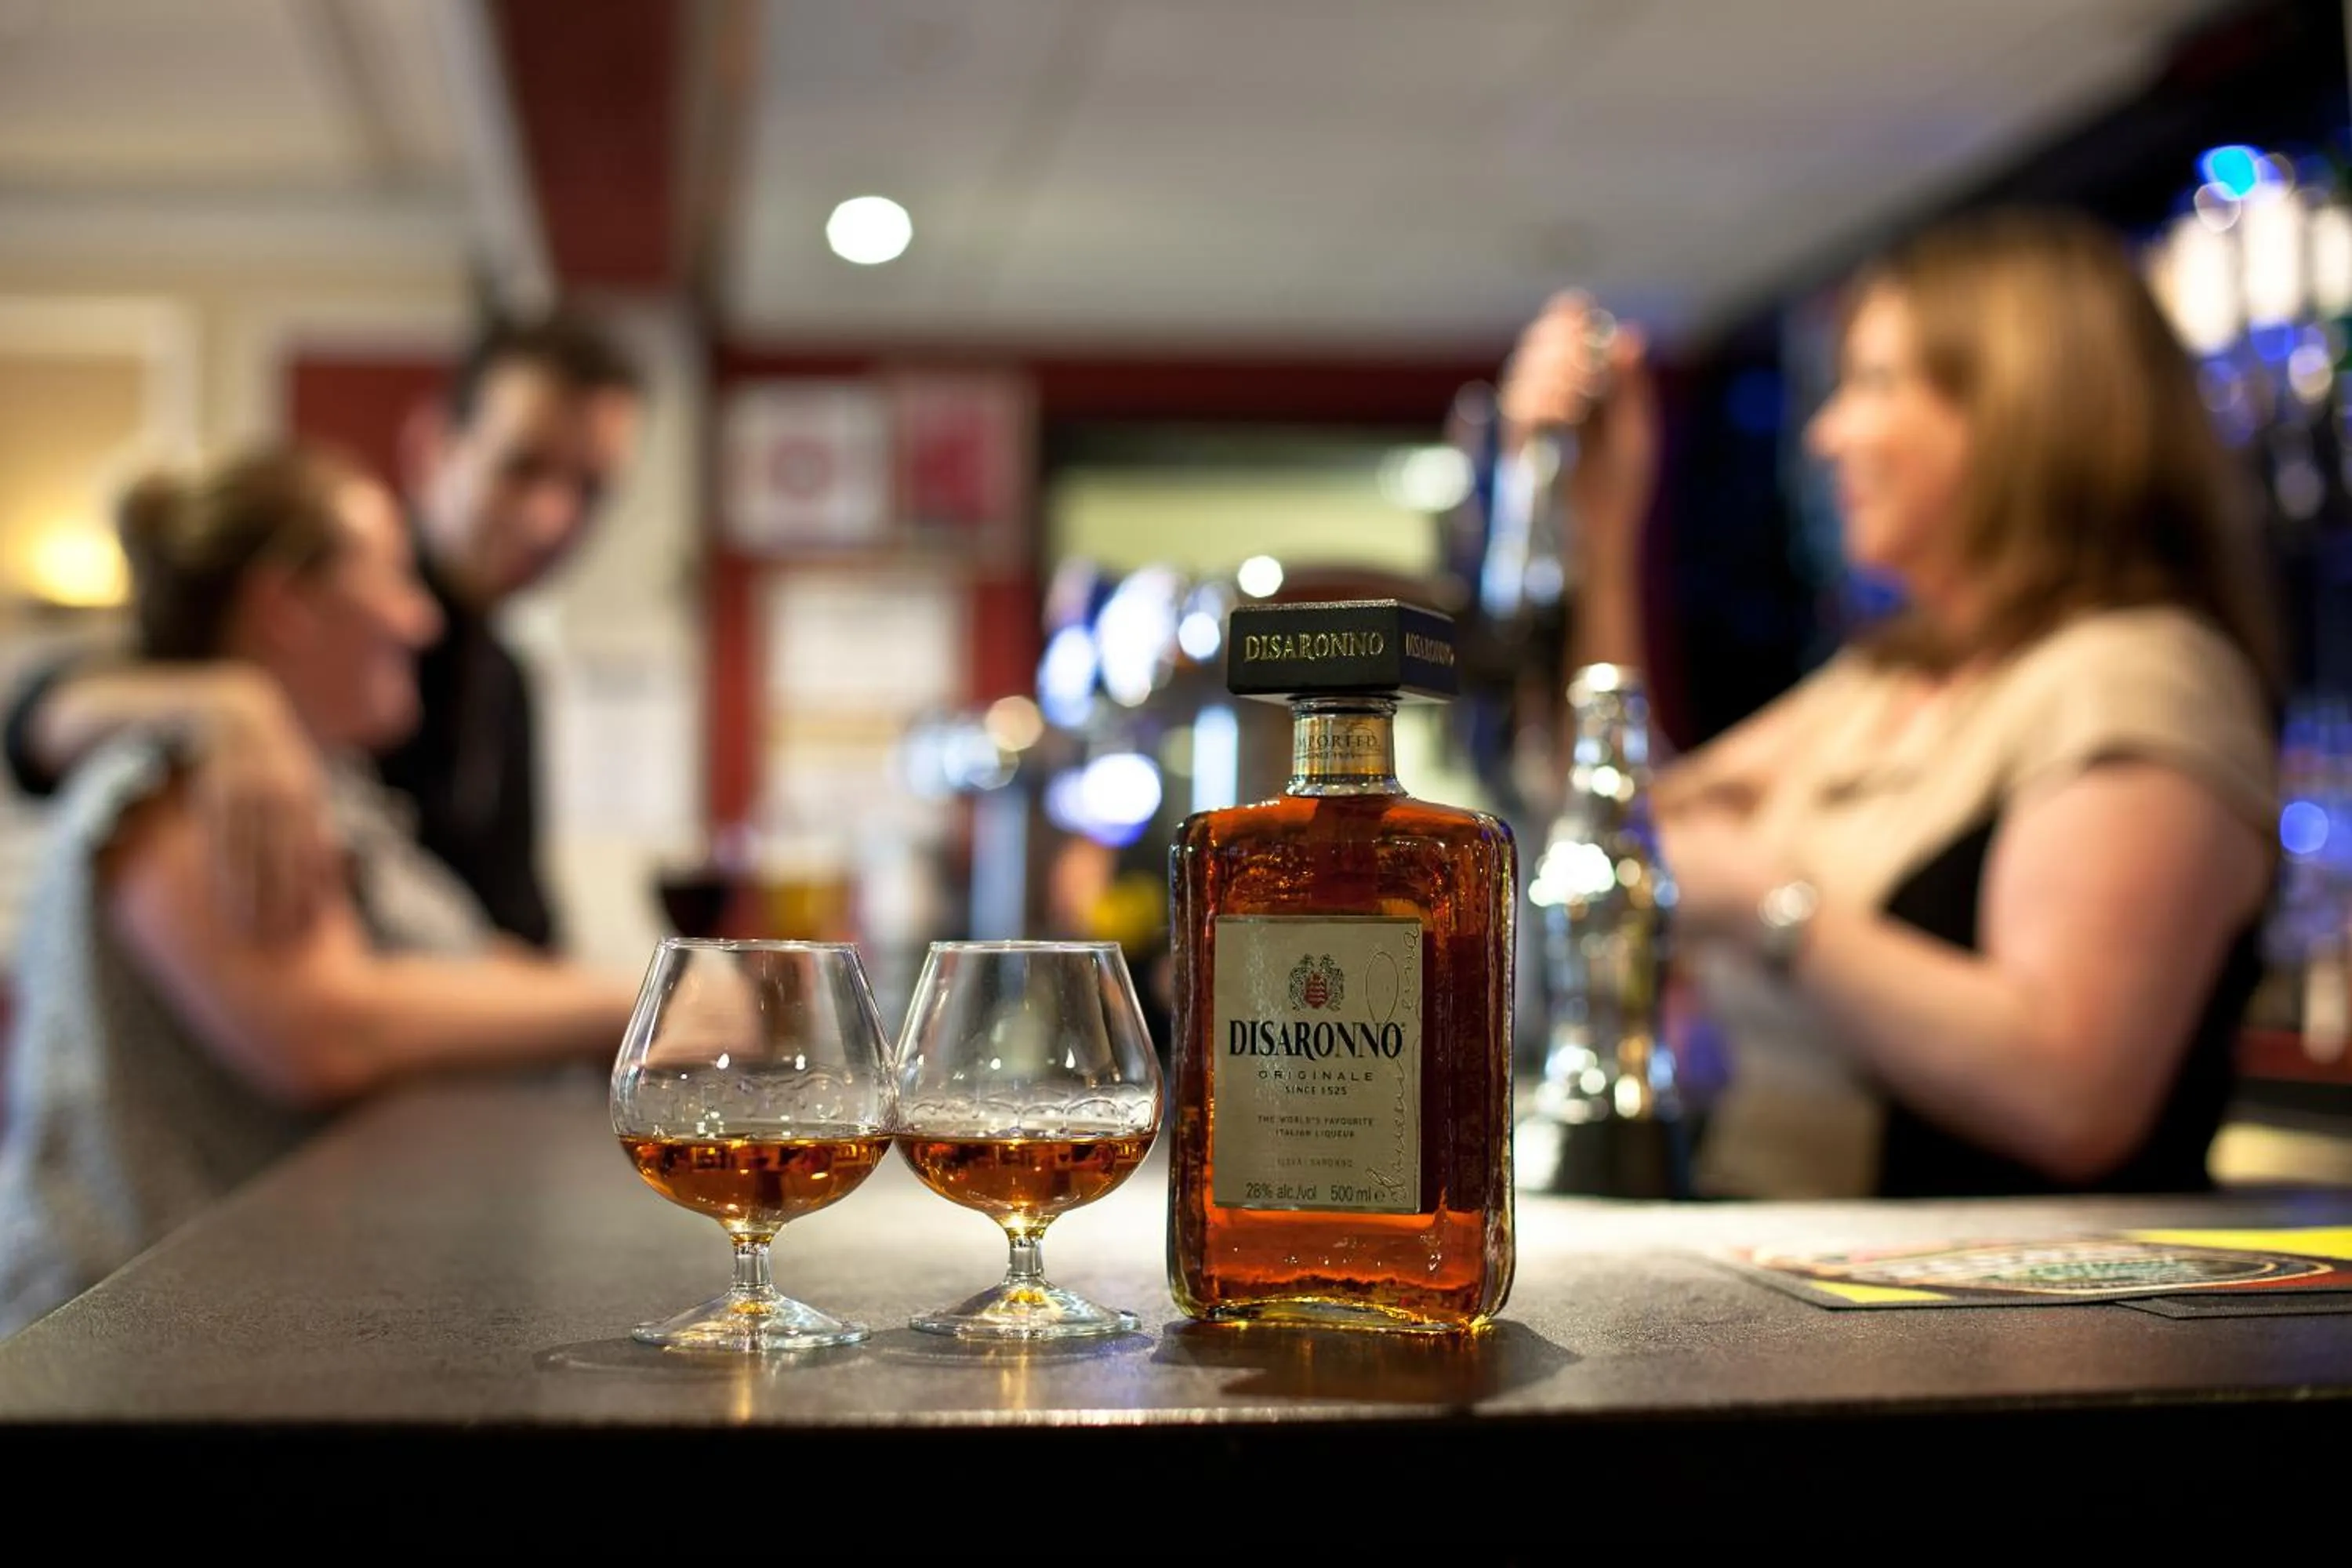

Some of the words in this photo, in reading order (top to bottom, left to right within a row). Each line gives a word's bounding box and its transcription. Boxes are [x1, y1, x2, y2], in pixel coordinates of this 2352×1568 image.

[1244, 631, 1385, 662] DISARONNO
[1229, 1020, 1403, 1061] DISARONNO
[1258, 1070, 1374, 1081] ORIGINALE
[1285, 1085, 1316, 1094] SINCE
[1321, 1086, 1347, 1095] 1525
[1258, 1115, 1275, 1124] THE
[1279, 1115, 1320, 1124] WORLD'S
[1324, 1116, 1374, 1127] FAVOURITE
[1276, 1128, 1312, 1137] ITALIAN
[1246, 1181, 1273, 1200] 28%
[1330, 1185, 1352, 1202] 500
[1357, 1186, 1371, 1203] ml
